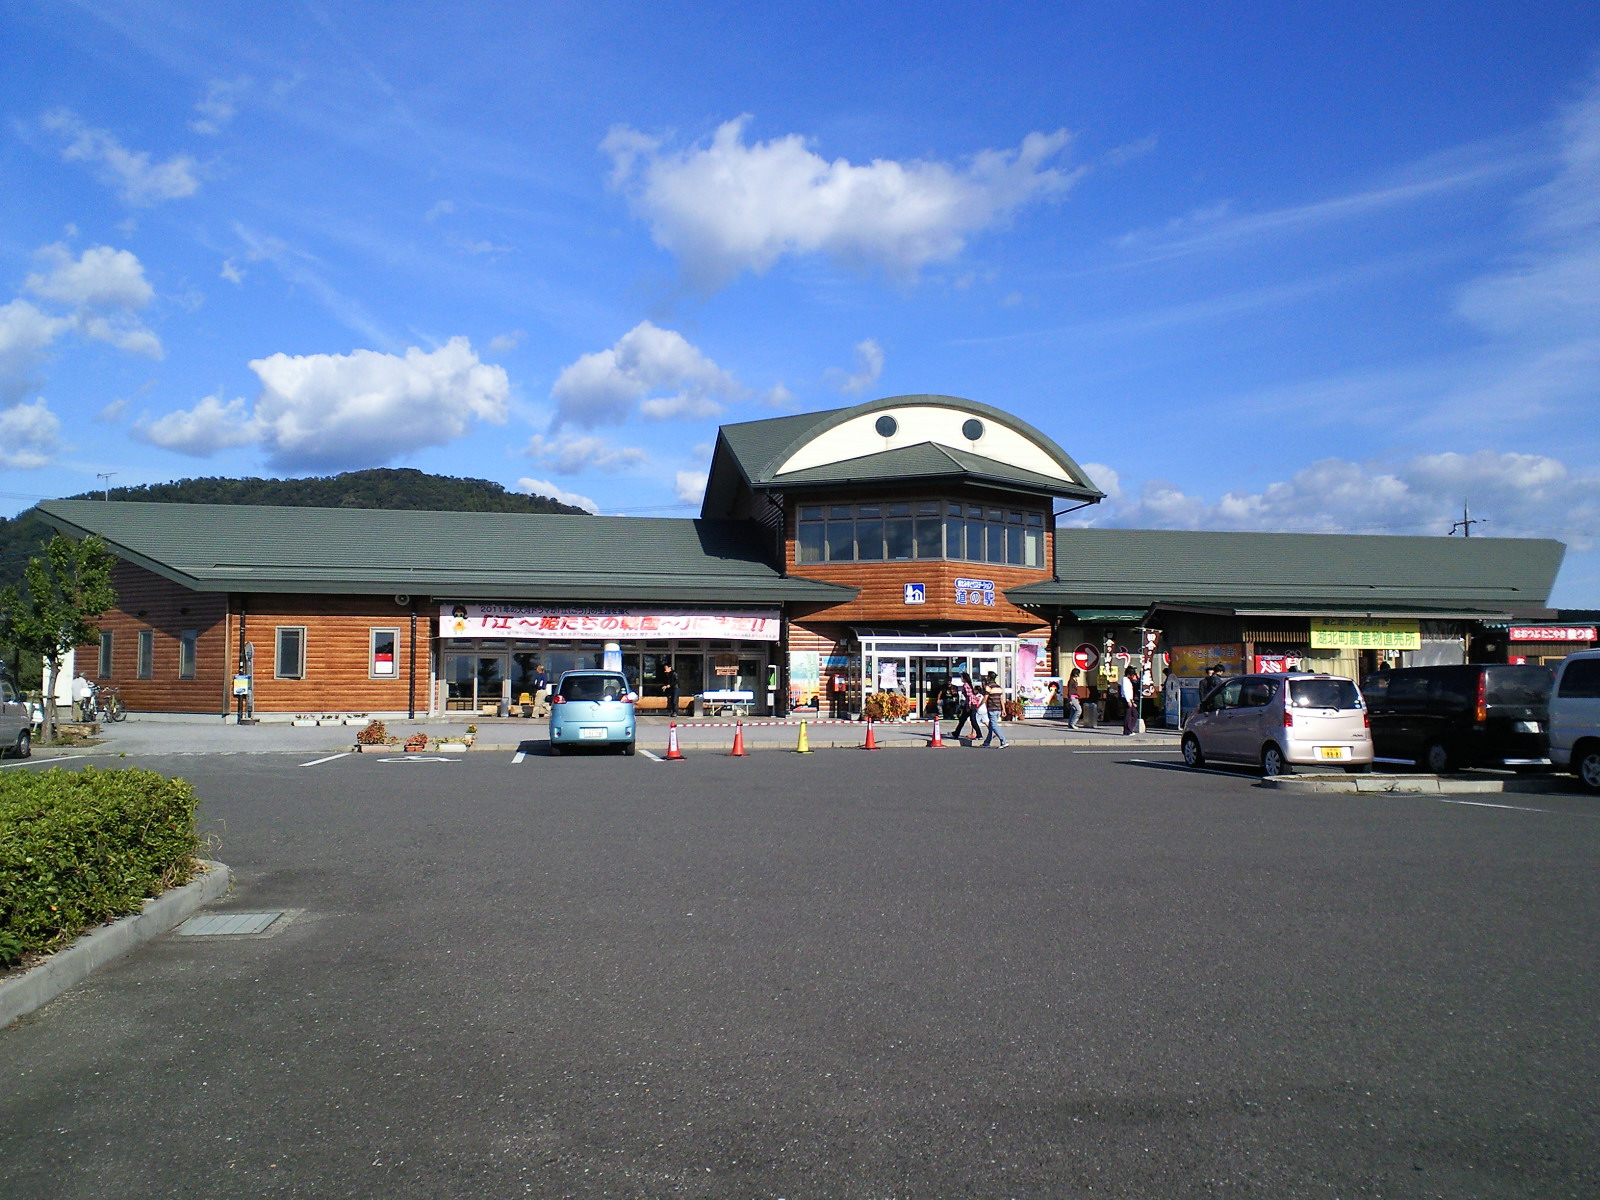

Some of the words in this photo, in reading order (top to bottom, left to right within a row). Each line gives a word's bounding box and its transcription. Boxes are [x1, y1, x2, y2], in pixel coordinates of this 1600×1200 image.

[956, 589, 995, 606] 道の駅
[1317, 630, 1415, 646] 湖北町農産物直売所
